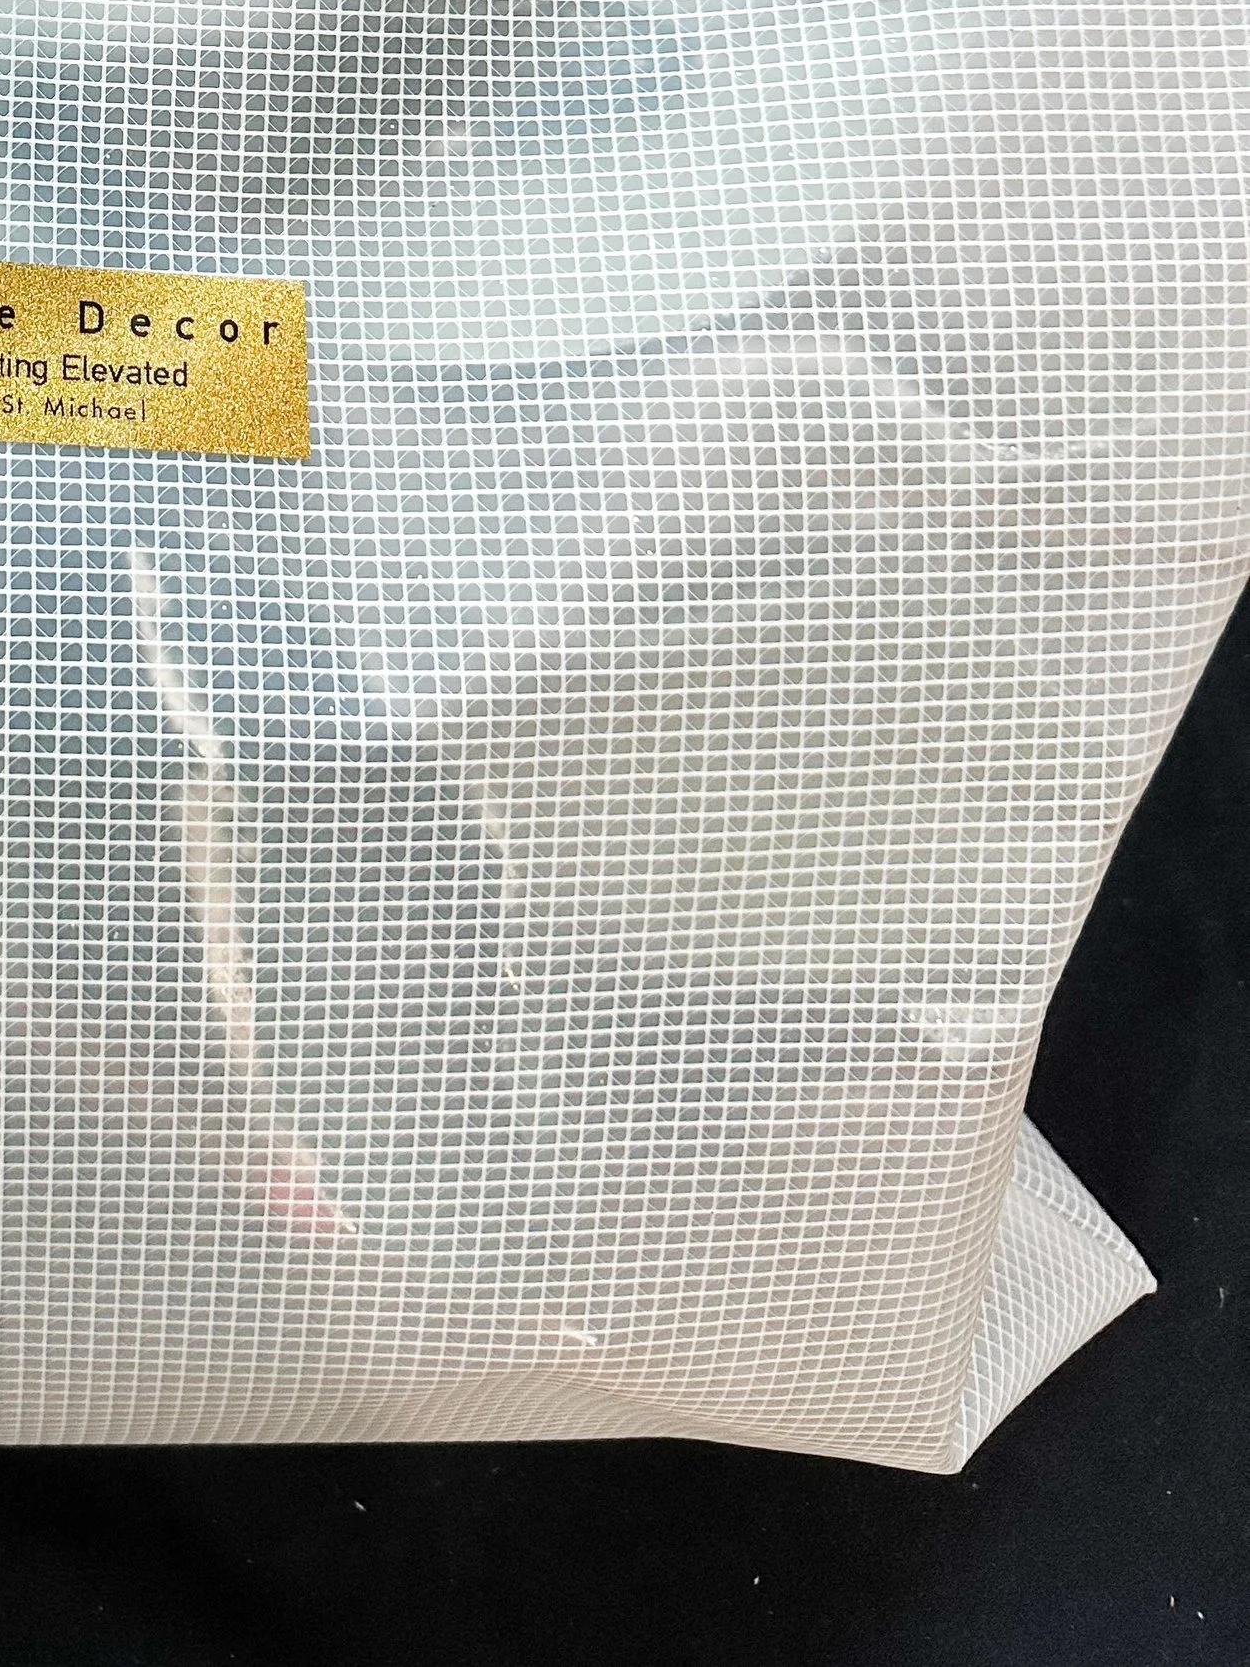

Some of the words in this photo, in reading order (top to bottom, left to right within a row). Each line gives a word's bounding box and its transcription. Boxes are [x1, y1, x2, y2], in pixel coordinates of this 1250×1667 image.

[79, 300, 281, 345] Decor
[62, 354, 188, 387] Elevated
[44, 396, 146, 422] Michael
